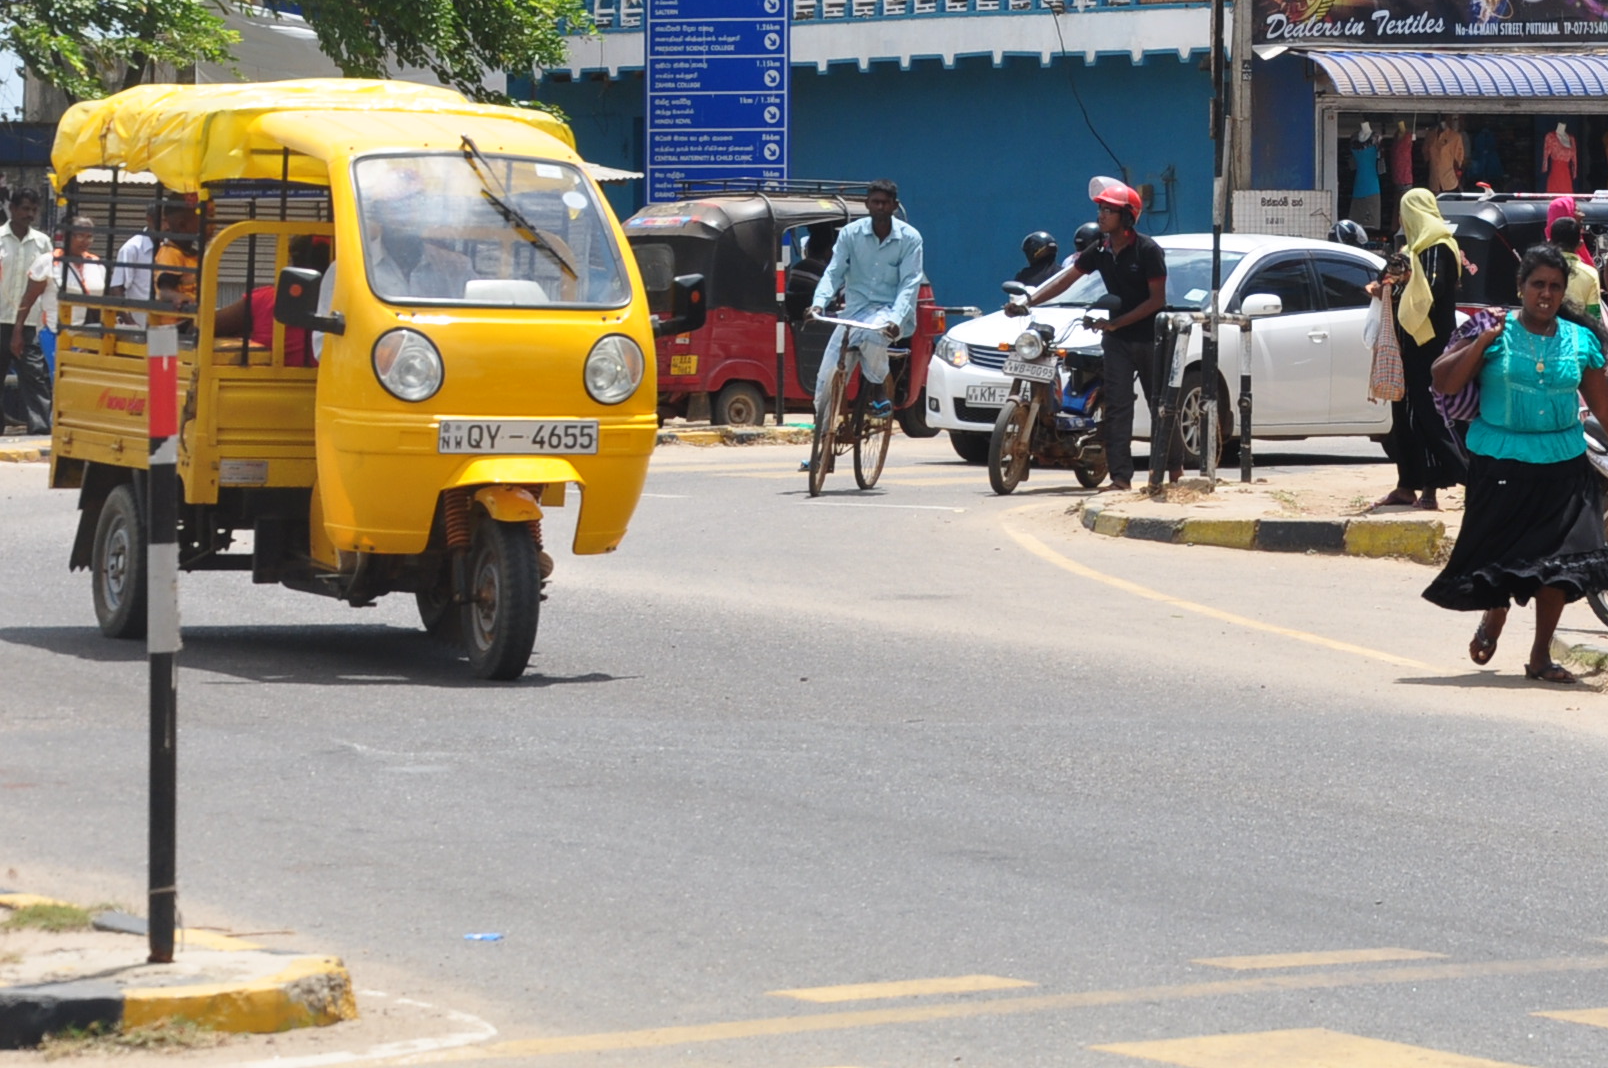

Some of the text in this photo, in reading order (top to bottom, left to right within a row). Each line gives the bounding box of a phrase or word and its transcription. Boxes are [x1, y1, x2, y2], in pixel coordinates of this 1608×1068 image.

[1266, 10, 1445, 39] Dealers in Textiles
[980, 389, 996, 402] KM
[467, 424, 501, 449] QY
[532, 424, 594, 450] 4655
